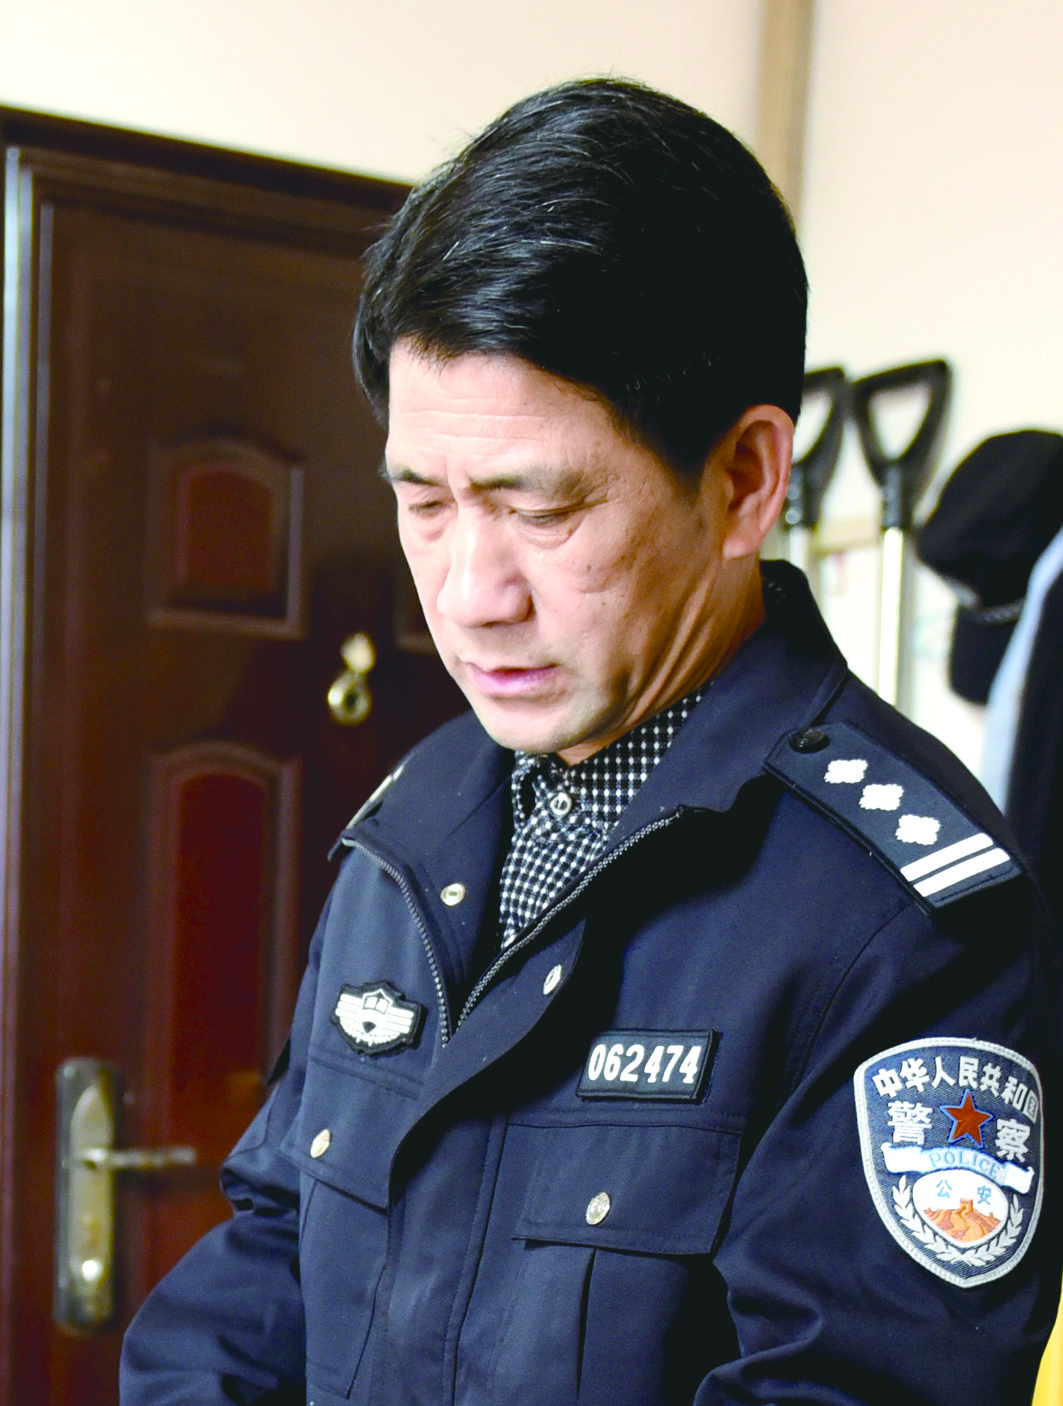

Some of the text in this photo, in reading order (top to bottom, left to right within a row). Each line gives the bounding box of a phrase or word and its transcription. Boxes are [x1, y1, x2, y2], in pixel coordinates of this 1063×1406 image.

[587, 1043, 702, 1084] 062474
[871, 1055, 1039, 1124] 中华人民共和国
[887, 1100, 1030, 1162] 警 察
[928, 1147, 1000, 1182] POLICE
